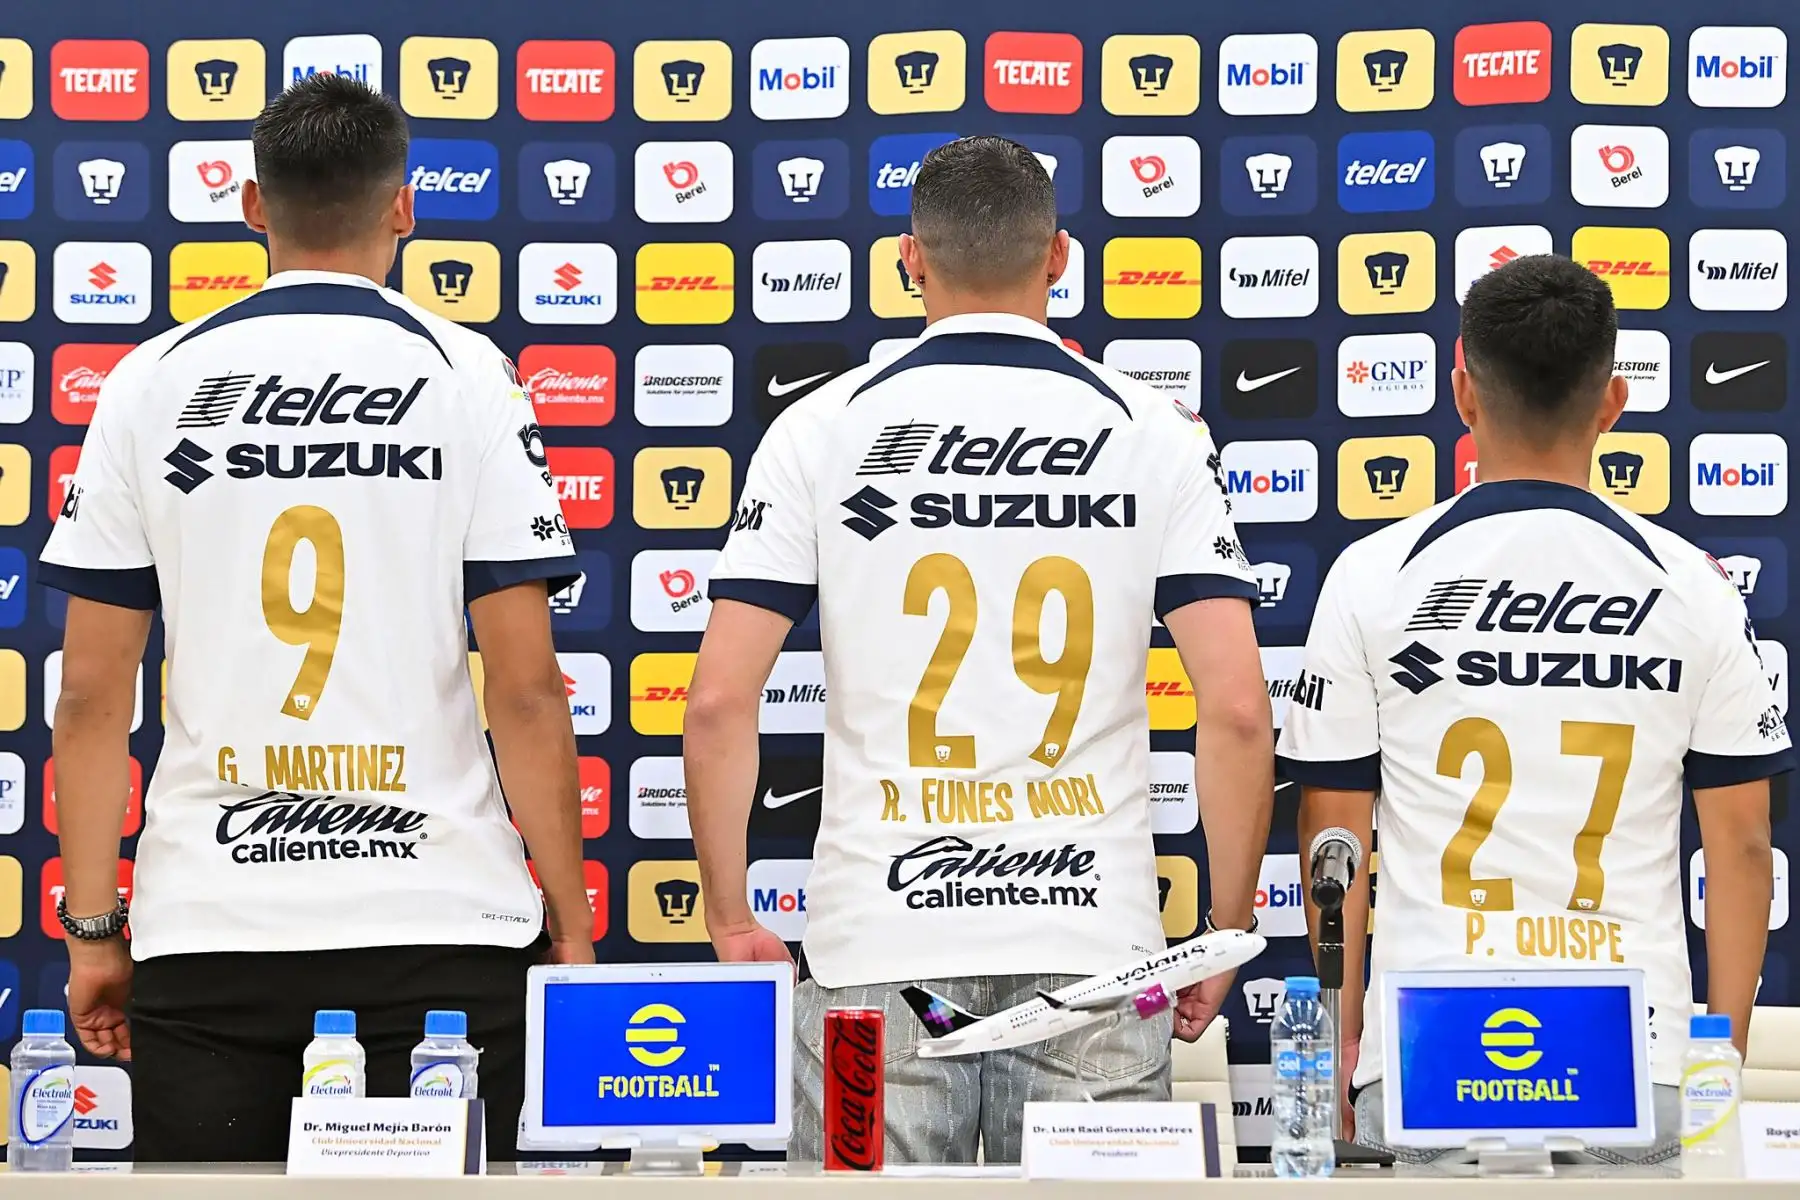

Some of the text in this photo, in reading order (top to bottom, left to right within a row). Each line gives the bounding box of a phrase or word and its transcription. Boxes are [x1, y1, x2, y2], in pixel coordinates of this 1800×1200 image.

[993, 59, 1072, 86] TECATE
[1227, 62, 1304, 87] Mobil
[1462, 49, 1541, 78] TECATE
[1696, 55, 1772, 79] Mobil
[59, 67, 138, 94] TECATE
[525, 68, 605, 94] TECATE
[759, 66, 835, 91] Mobil
[410, 166, 492, 194] telcel
[876, 161, 922, 189] tel
[1344, 156, 1428, 186] telcel
[1611, 167, 1643, 189] Berel
[209, 181, 241, 204] Berel
[675, 182, 707, 205] Berel
[1142, 176, 1174, 199] Berel
[1116, 271, 1190, 286] DHL
[1260, 267, 1311, 287] Mifel
[1586, 259, 1660, 277] DHL
[1729, 261, 1779, 281] Mifel
[184, 275, 258, 291] DHL
[649, 276, 722, 291] DHL
[793, 272, 842, 293] Mifel
[70, 293, 136, 306] SUZUKI
[535, 294, 602, 307] SUZUKI
[526, 367, 609, 392] Caliente
[643, 375, 724, 387] BRIDGESTONE
[1371, 360, 1424, 381] GNP
[241, 372, 429, 427] telcel
[1371, 383, 1424, 392] SEGUROS
[225, 441, 443, 482] SUZUKI
[928, 424, 1113, 477] telcel
[1228, 468, 1305, 494] Mobil
[1697, 462, 1774, 487] Mobil
[551, 475, 605, 501] CATE
[909, 492, 1136, 529] SUZUKI
[261, 504, 346, 722] 9
[671, 590, 704, 614] Berel
[1475, 579, 1664, 637] telcel
[902, 552, 1095, 769] 29
[1455, 650, 1683, 693] SUZUKI
[644, 686, 688, 702] DH
[787, 684, 827, 704] Mife
[1145, 682, 1188, 697] HL
[1292, 668, 1326, 712] bil
[571, 705, 596, 716] UKI
[217, 743, 408, 793] G. MARTINEZ
[637, 786, 687, 799] BRIDGES
[879, 773, 1105, 824] R. FUNES MORI
[1149, 783, 1190, 795] ESTONE
[215, 790, 429, 846] Caliente
[1435, 716, 1636, 912] 27
[231, 836, 419, 865] caliente.mx
[886, 835, 1096, 893] Caliente
[905, 881, 1099, 910] caliente.mx
[1254, 883, 1303, 908] obil
[1465, 911, 1625, 963] P. QUISPE
[597, 1074, 720, 1099] FOOTBALL
[1456, 1078, 1580, 1102] FOOTBALL
[73, 1118, 118, 1130] ZUKI
[303, 1122, 322, 1132] Dr.
[325, 1122, 370, 1134] Miguel
[411, 1122, 452, 1133] Barón
[1032, 1126, 1049, 1134] Dr.
[1052, 1126, 1075, 1134] Luis
